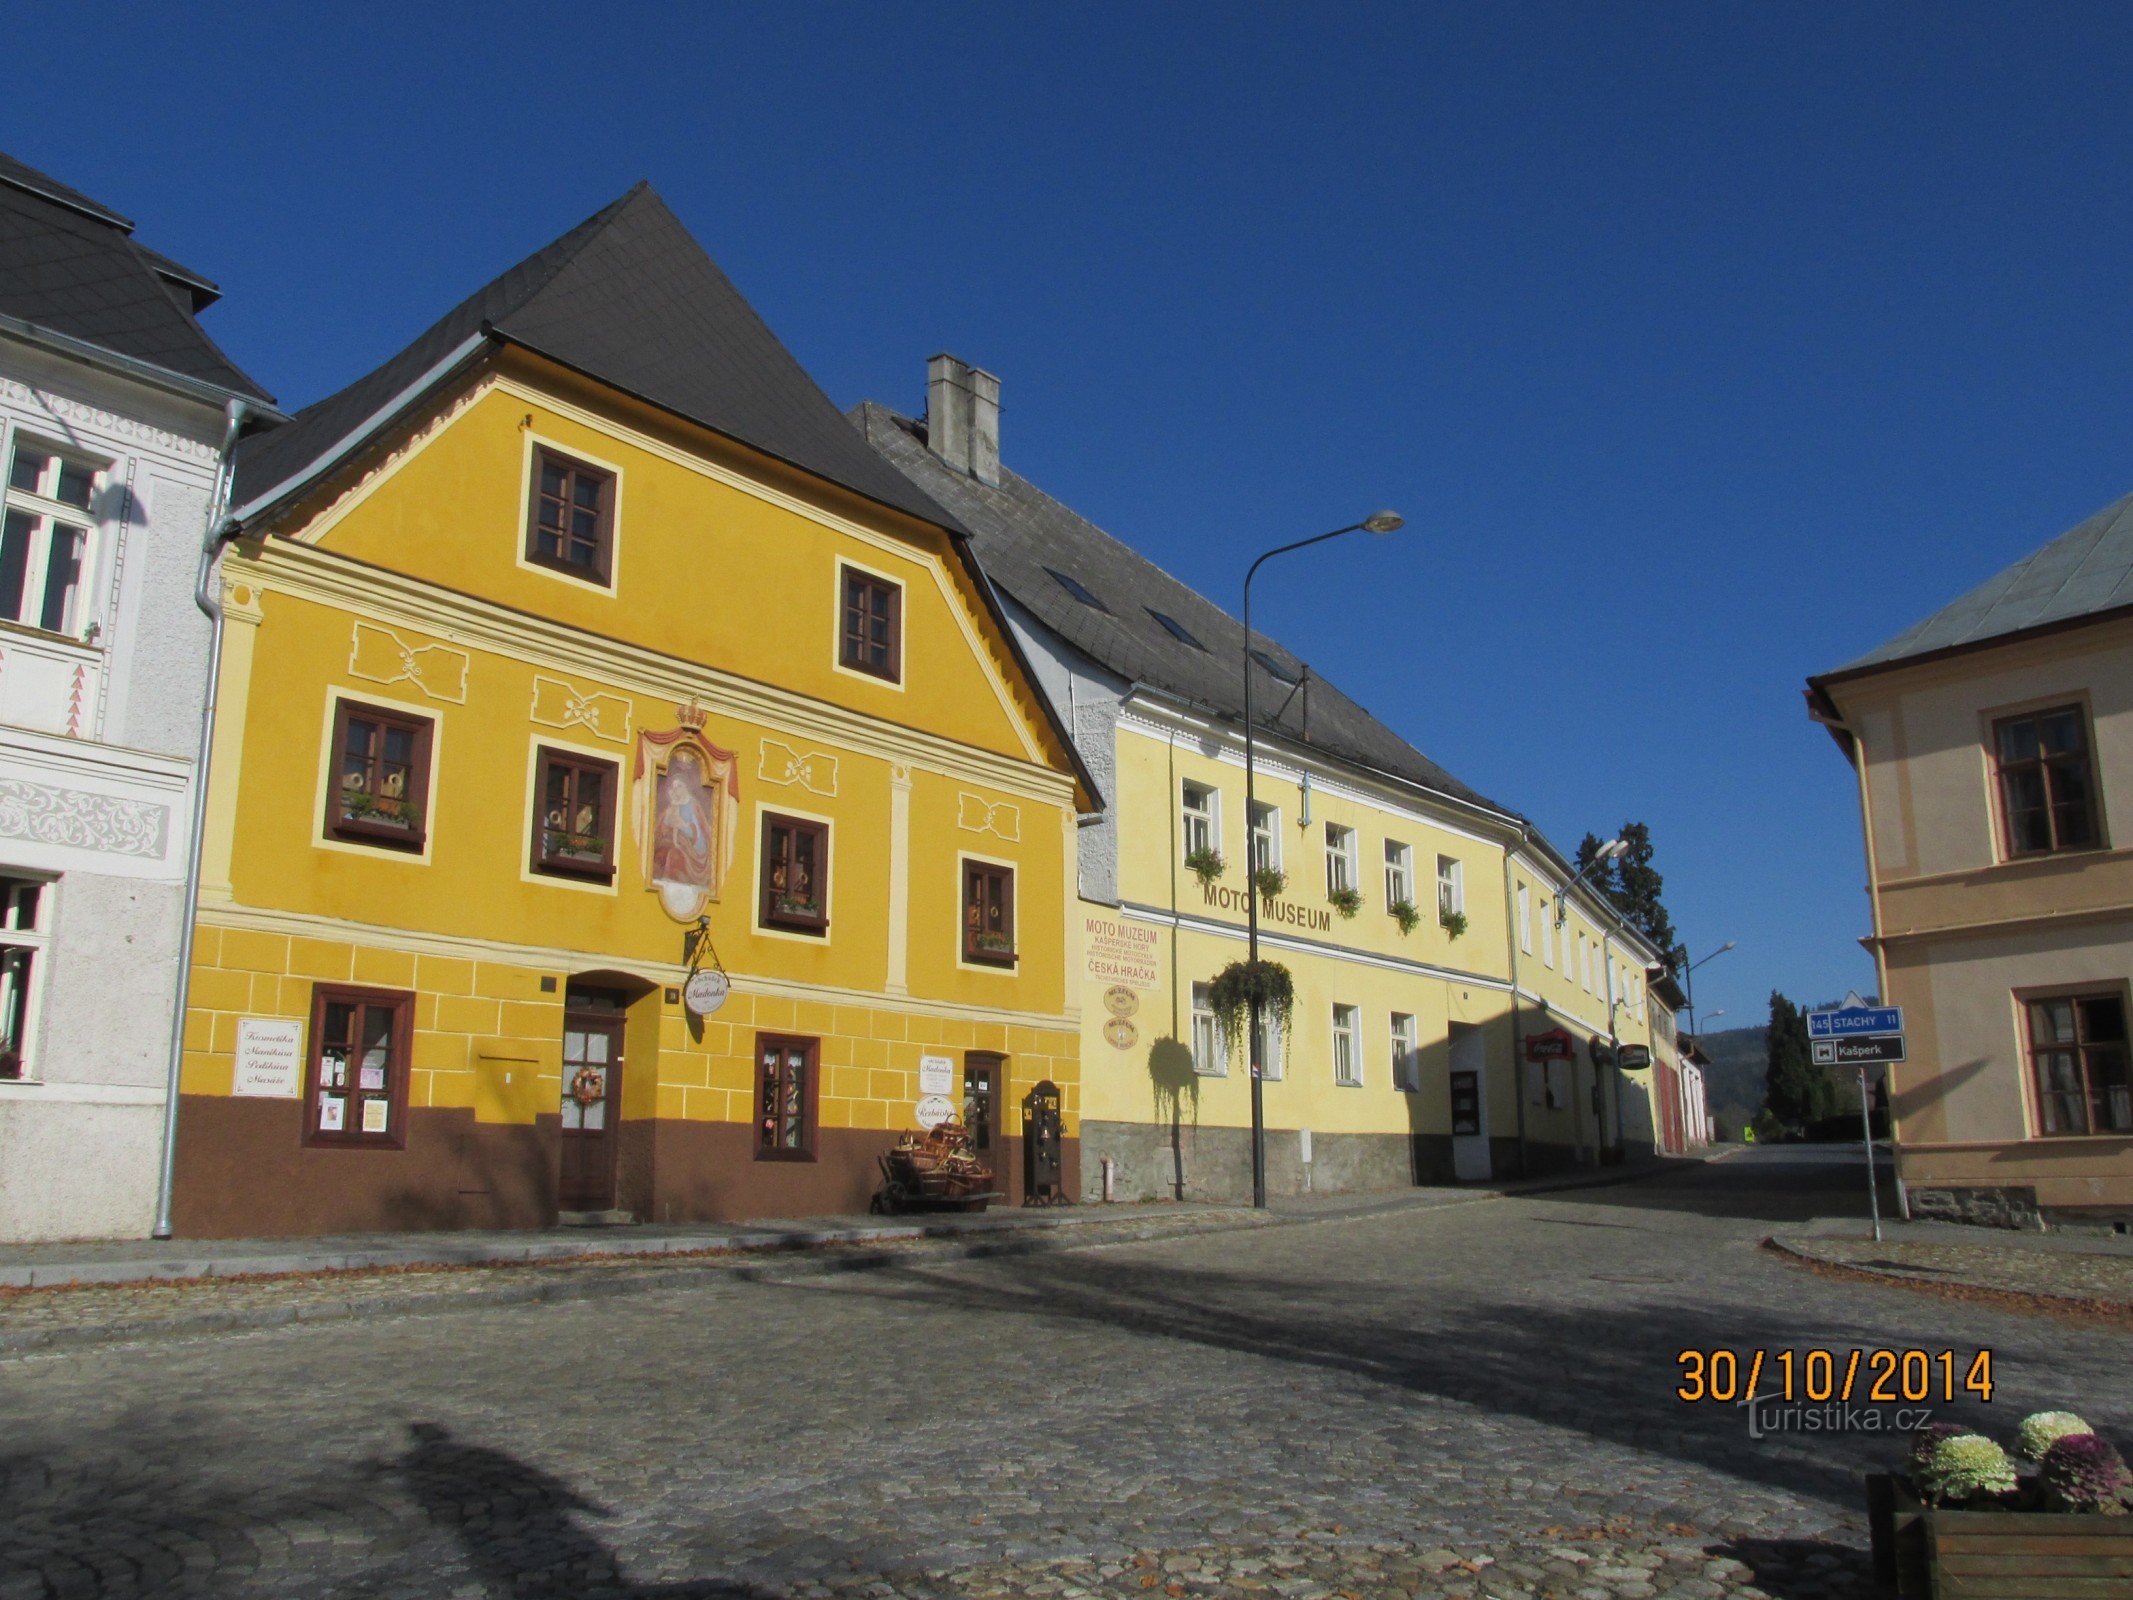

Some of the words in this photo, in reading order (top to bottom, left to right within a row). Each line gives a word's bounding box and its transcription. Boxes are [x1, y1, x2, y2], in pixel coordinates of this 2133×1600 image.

[1203, 883, 1250, 914] MOTO
[1262, 897, 1331, 932] MUSEUM
[1086, 919, 1116, 937] MOTO
[1118, 925, 1157, 944] MUZEUM
[1133, 943, 1150, 952] HORY
[1088, 959, 1119, 975] ČESKÁ
[1120, 966, 1157, 981] HRAČKA
[687, 988, 725, 999] Madonka
[1811, 1019, 1829, 1030] 145
[1833, 1016, 1876, 1028] STACHY
[1886, 1014, 1896, 1025] 11
[1839, 1044, 1882, 1057] Kašperk
